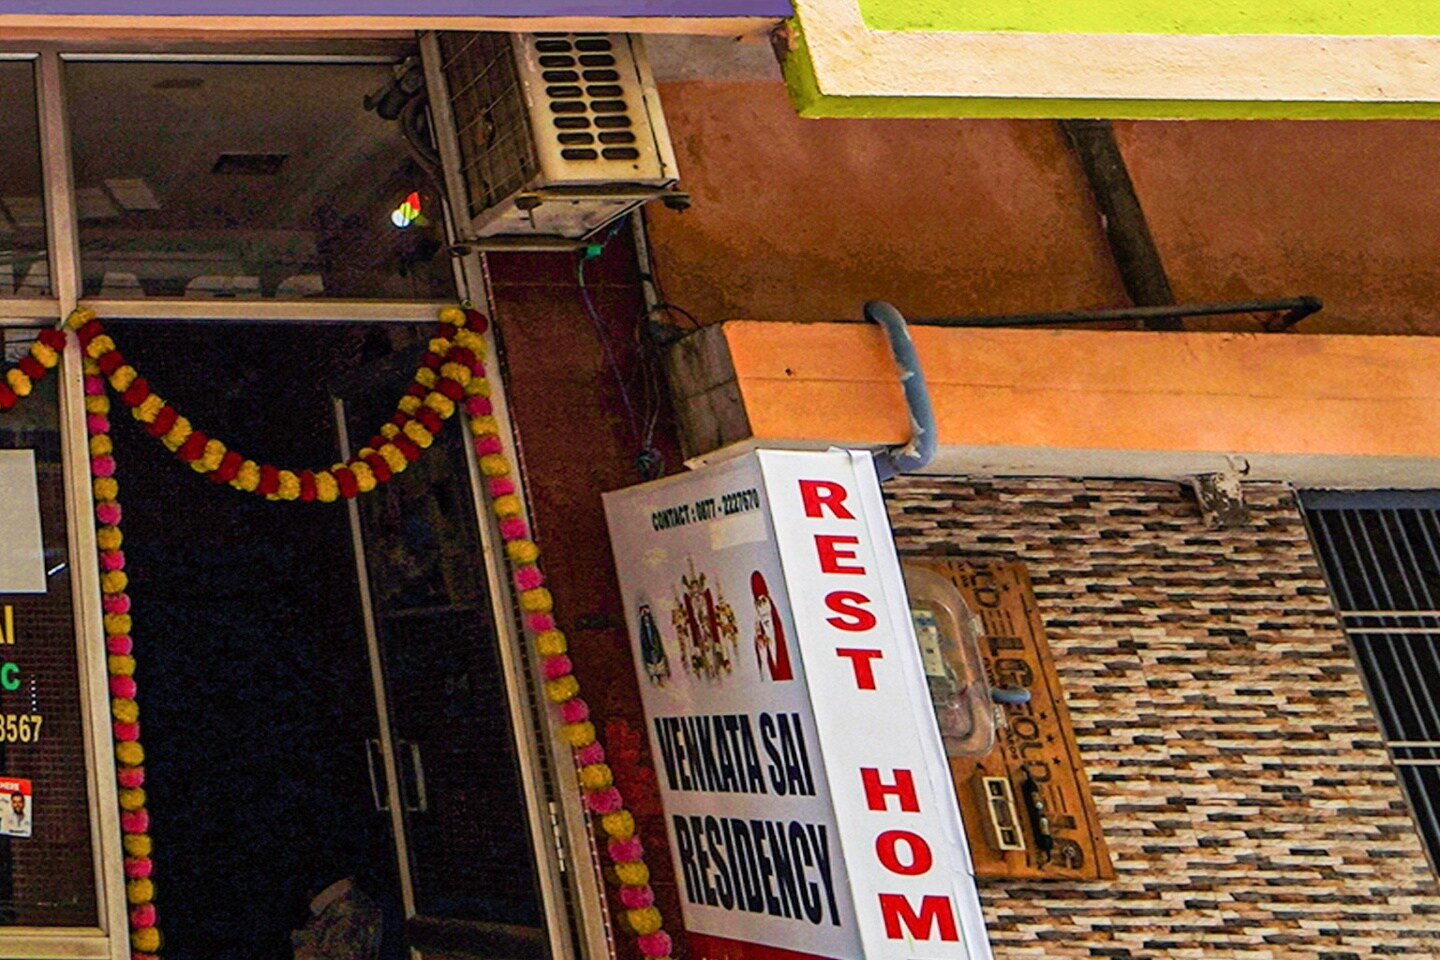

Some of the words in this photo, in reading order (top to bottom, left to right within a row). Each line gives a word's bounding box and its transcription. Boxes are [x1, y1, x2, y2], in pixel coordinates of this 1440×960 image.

[652, 504, 690, 532] CONTACT
[798, 479, 883, 690] REST
[0, 782, 20, 791] HERE
[655, 714, 760, 794] VENKATA
[761, 712, 816, 797] SAI
[672, 814, 842, 927] RESIDENCY
